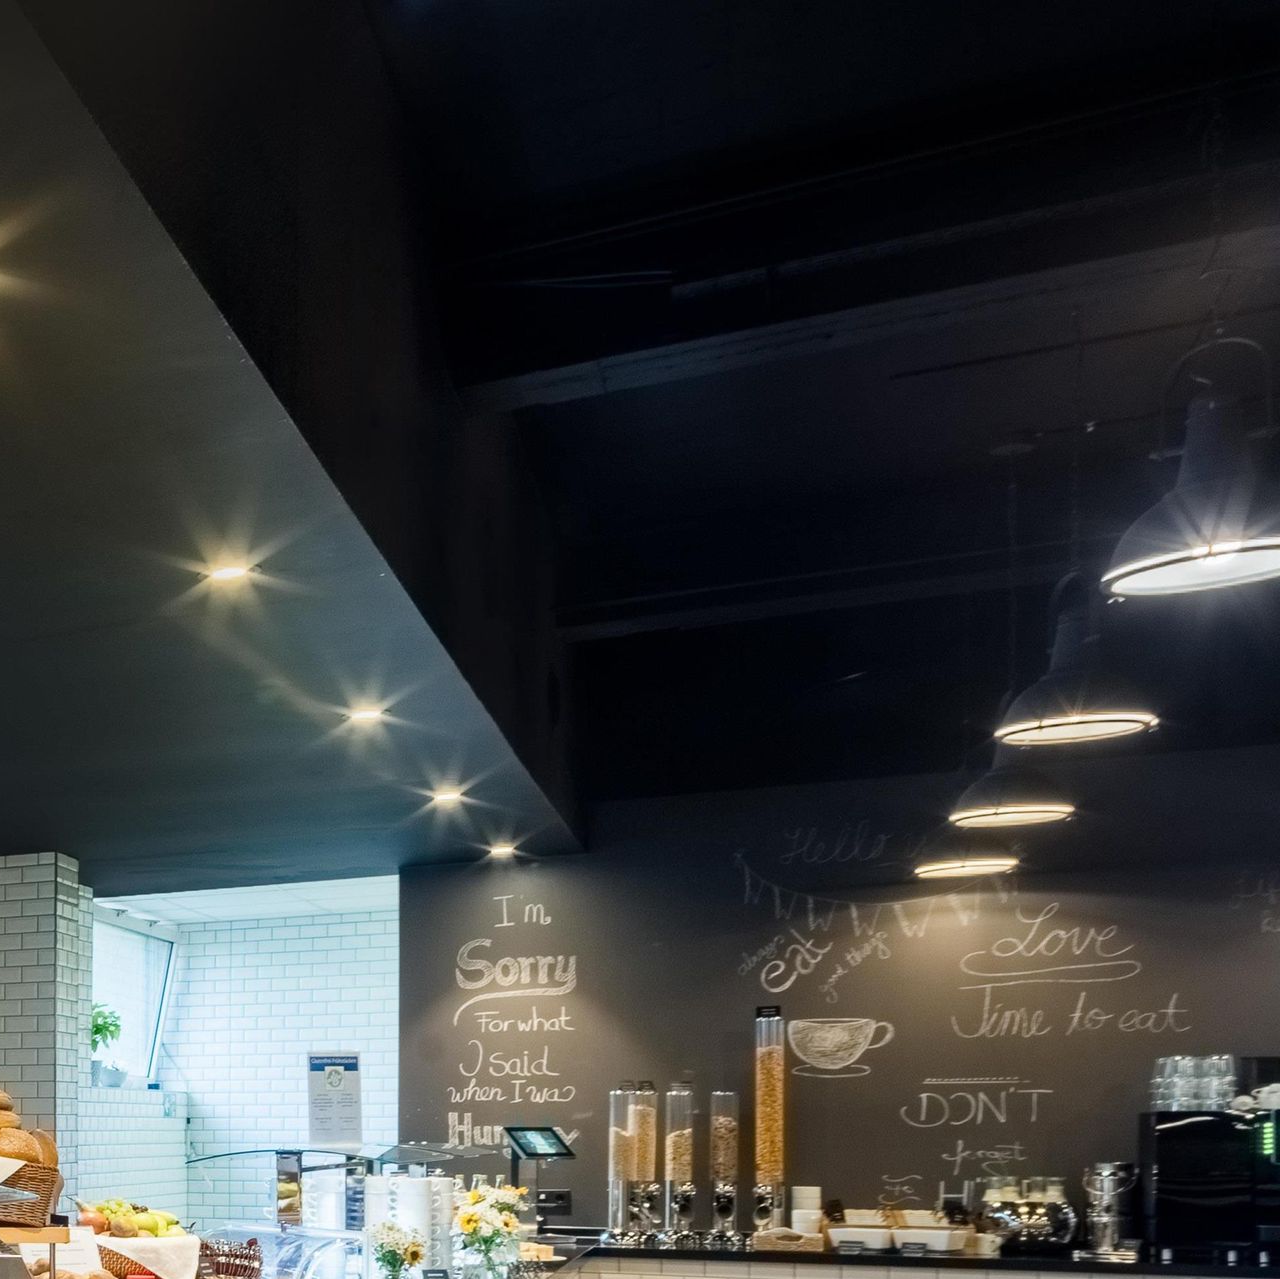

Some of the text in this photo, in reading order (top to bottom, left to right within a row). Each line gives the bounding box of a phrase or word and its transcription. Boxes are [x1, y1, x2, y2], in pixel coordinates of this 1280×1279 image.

[492, 894, 552, 927] I'm
[991, 902, 1135, 957] Love
[454, 938, 577, 1002] Sorry
[760, 929, 834, 993] eat
[951, 985, 1192, 1038] Time to eat
[442, 1112, 580, 1151] Huny
[900, 1087, 1054, 1128] DON'T
